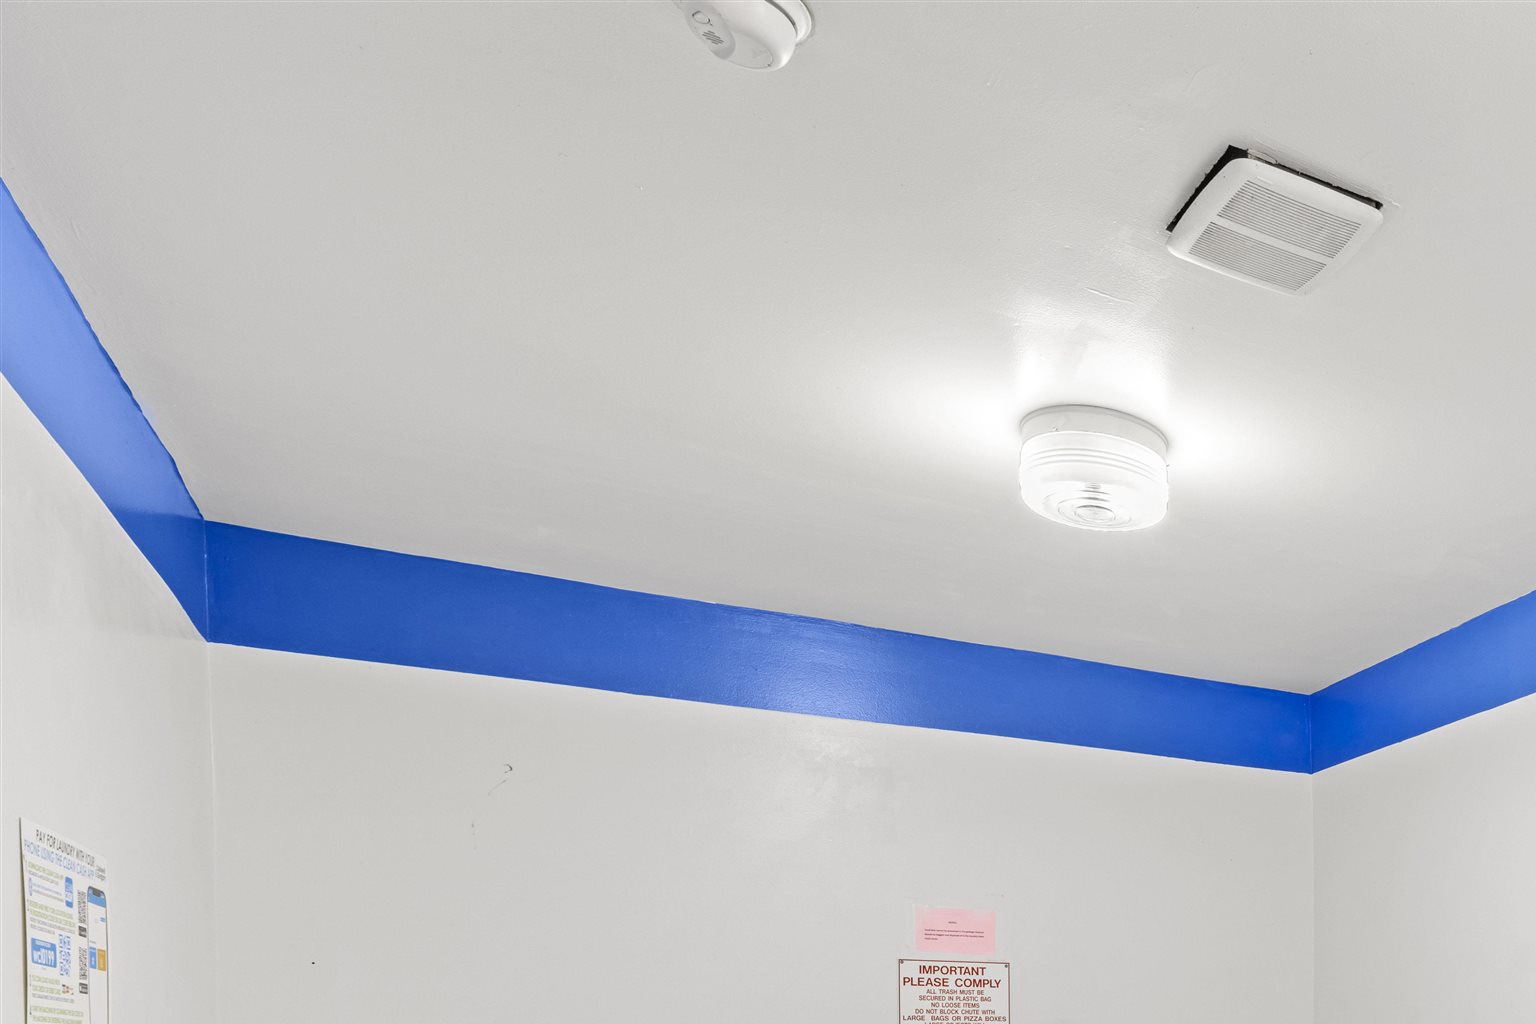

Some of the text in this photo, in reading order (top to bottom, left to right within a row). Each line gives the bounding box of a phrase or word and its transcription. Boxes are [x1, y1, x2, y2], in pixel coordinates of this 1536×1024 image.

[919, 965, 986, 976] IMPORTANT
[903, 977, 1001, 988] PLEASE COMPLY
